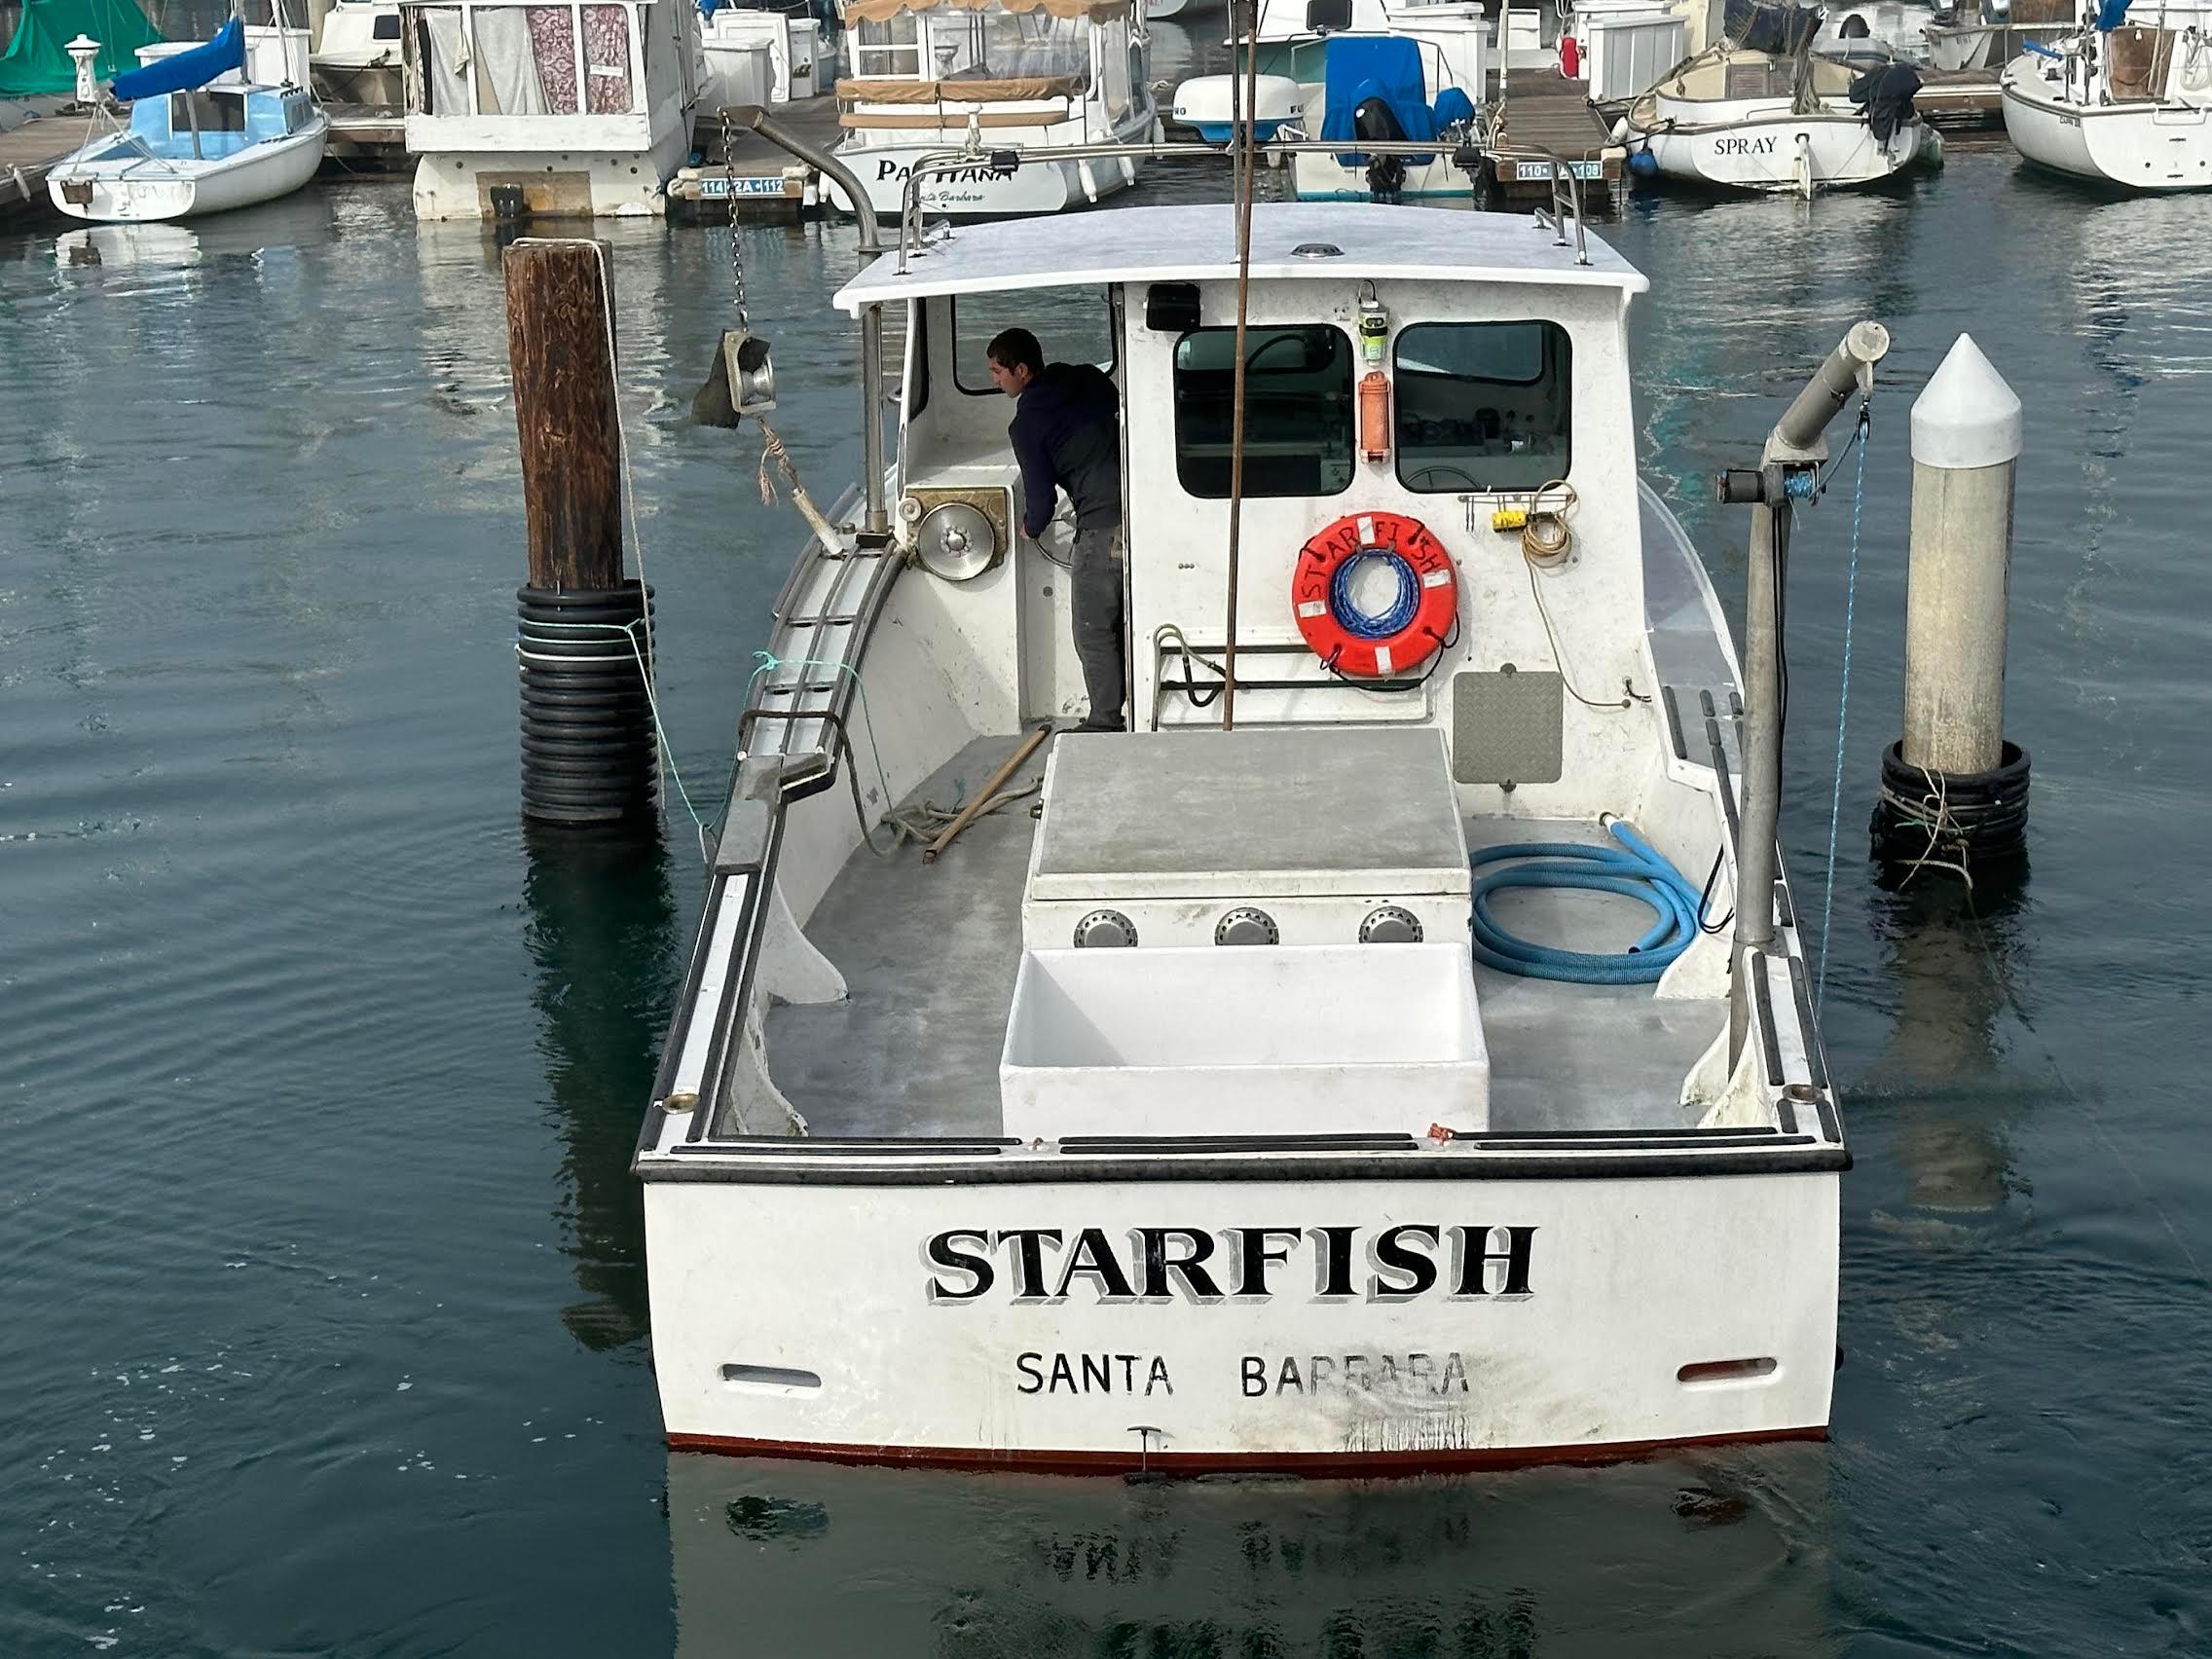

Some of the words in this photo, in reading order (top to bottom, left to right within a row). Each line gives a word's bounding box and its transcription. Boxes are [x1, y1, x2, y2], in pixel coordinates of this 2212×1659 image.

[1714, 136, 1778, 156] SPRAY
[1520, 166, 1541, 177] 110
[1578, 165, 1599, 176] 108
[702, 180, 724, 193] 114
[763, 179, 784, 193] 112
[919, 1224, 1540, 1307] STARFISH
[1016, 1351, 1173, 1396] SANTA
